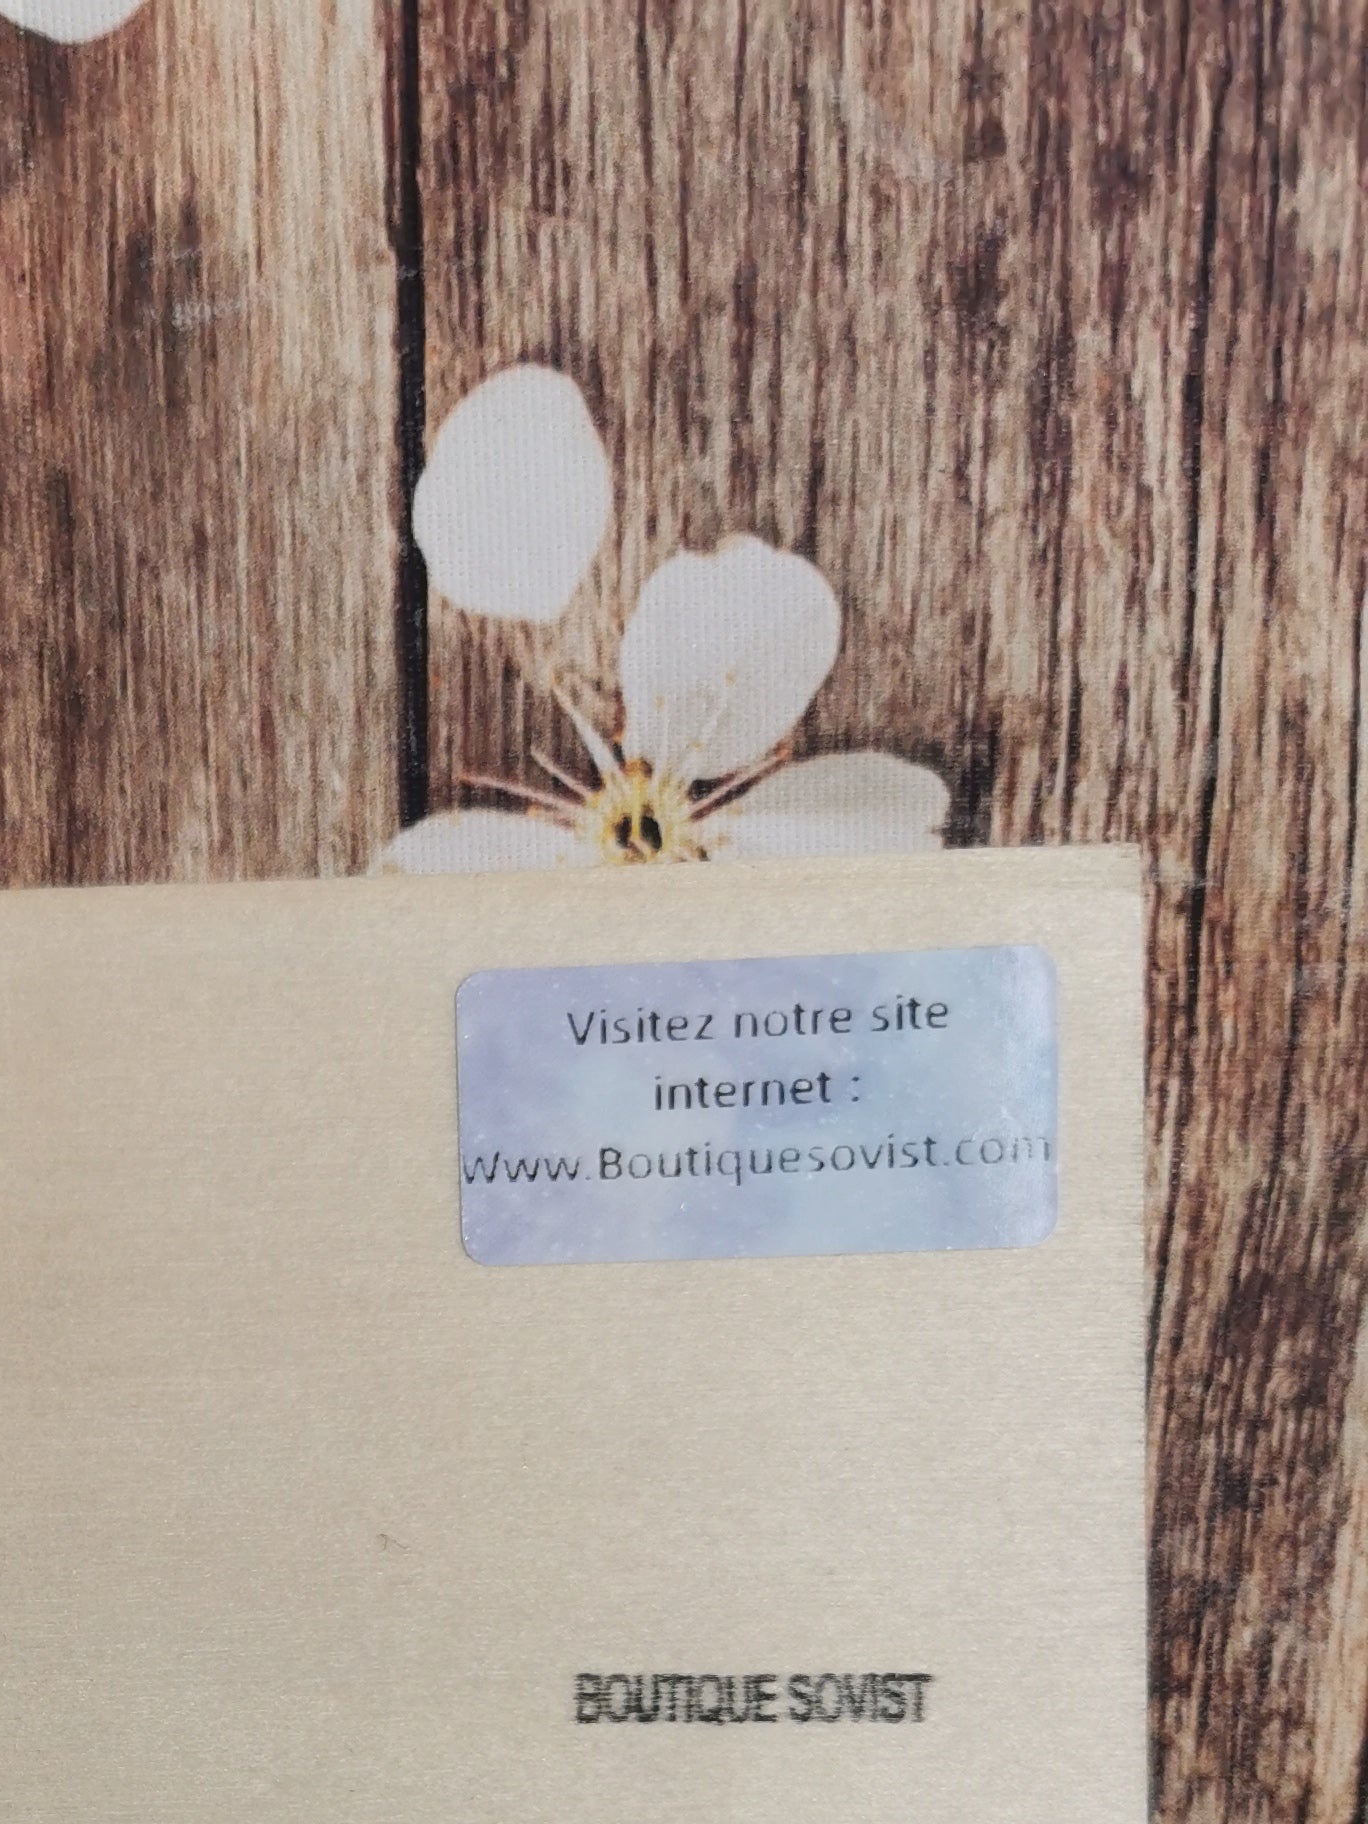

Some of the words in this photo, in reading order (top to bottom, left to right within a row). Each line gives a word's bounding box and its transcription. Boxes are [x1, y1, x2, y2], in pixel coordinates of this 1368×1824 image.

[567, 1007, 714, 1046] Visitez
[734, 1000, 853, 1039] notre
[871, 994, 950, 1031] site
[654, 1071, 833, 1111] internet
[574, 1672, 779, 1725] BOUTIQUE
[786, 1672, 933, 1725] SOVIST
